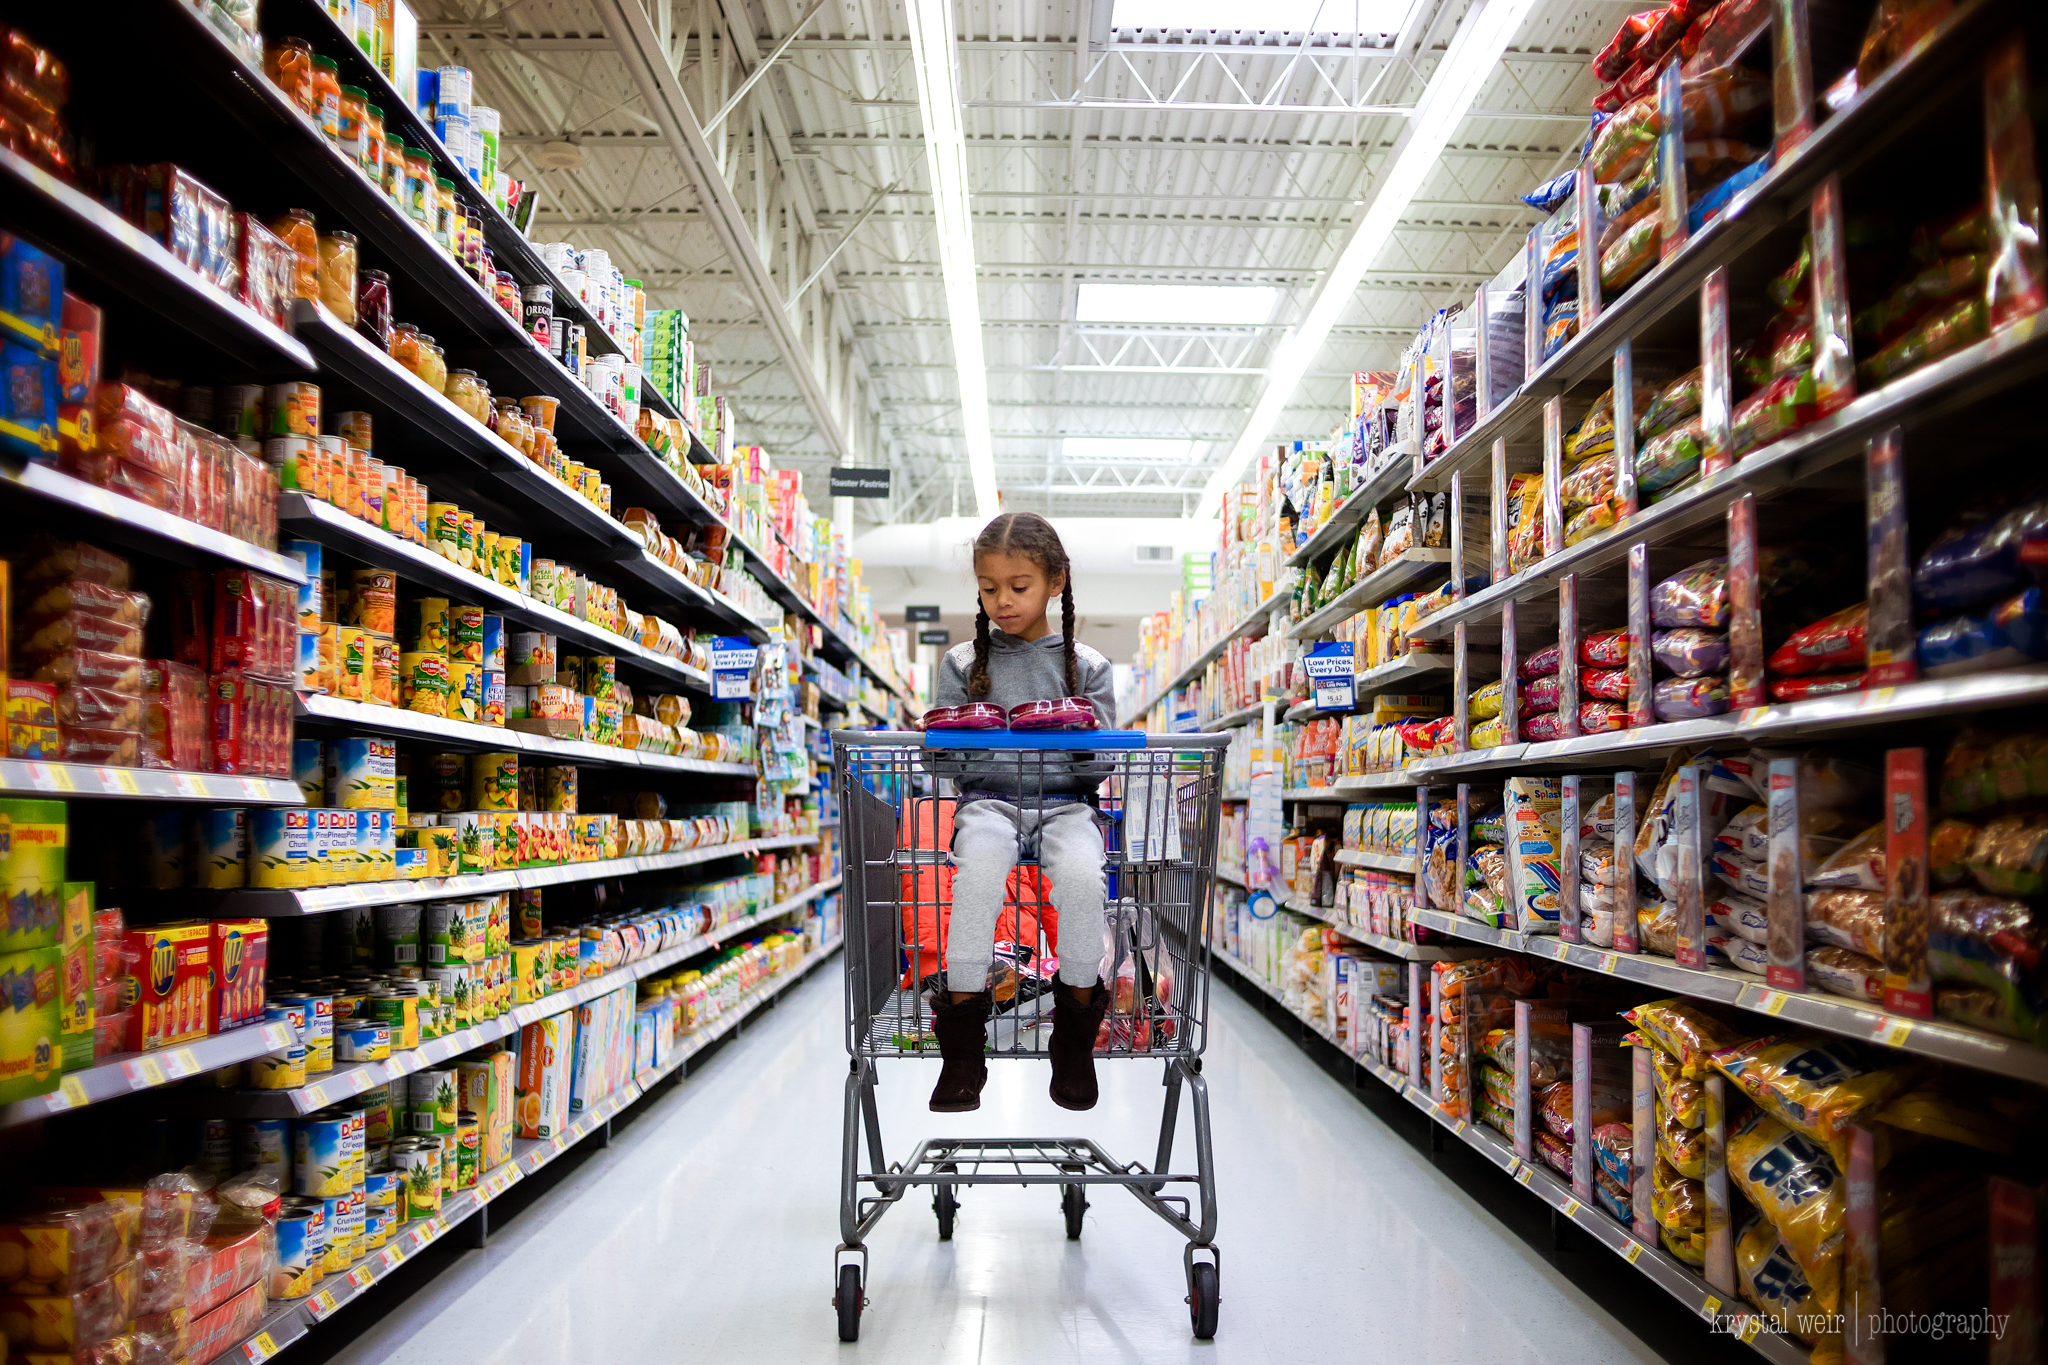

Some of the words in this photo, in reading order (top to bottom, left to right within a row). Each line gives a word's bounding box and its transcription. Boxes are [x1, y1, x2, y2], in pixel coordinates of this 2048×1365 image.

[526, 305, 551, 317] OREGO
[831, 478, 859, 488] Toaster
[860, 479, 890, 489] Pastries
[284, 832, 308, 842] Pineapp
[150, 945, 175, 992] RITZ
[223, 937, 244, 975] RITZ
[75, 1000, 86, 1017] 20
[35, 1043, 51, 1064] 20
[530, 1024, 539, 1058] Mandarin
[528, 1058, 538, 1087] Oranges
[458, 1074, 468, 1112] MANDA
